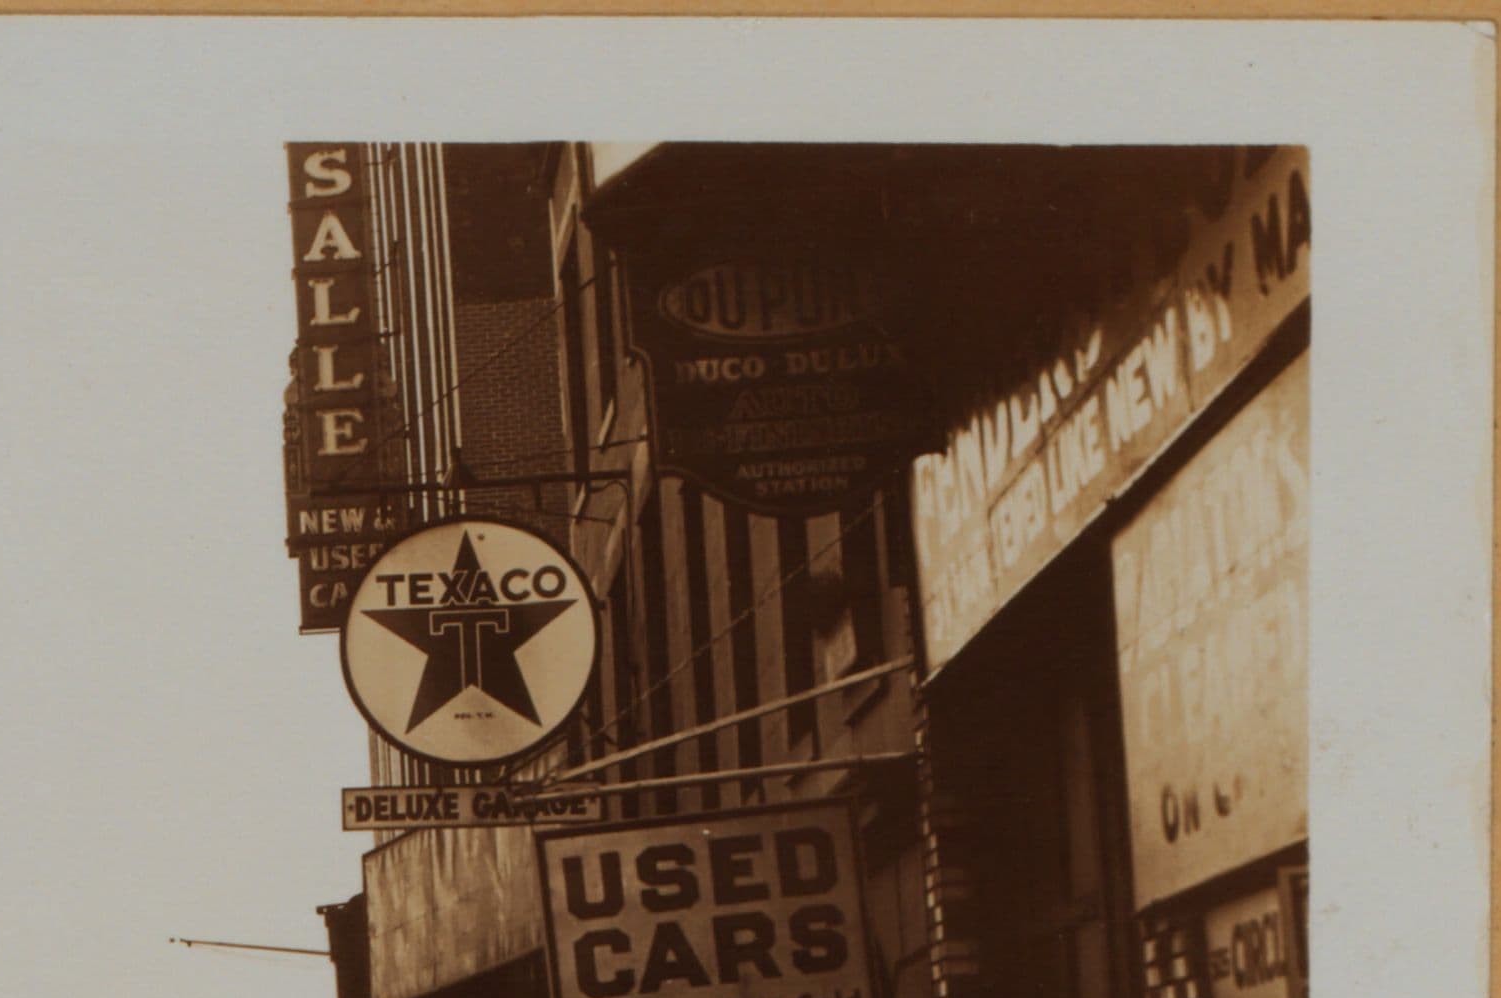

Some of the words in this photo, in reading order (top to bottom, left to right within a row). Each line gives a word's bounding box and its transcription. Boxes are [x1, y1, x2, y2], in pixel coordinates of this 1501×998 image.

[303, 149, 368, 457] SALLE
[675, 353, 767, 384] DUCO
[1106, 306, 1177, 452] NEW
[299, 508, 366, 535] NEW
[375, 565, 567, 608] TEXACO
[355, 793, 460, 822] DELUXE
[561, 826, 838, 920] USED
